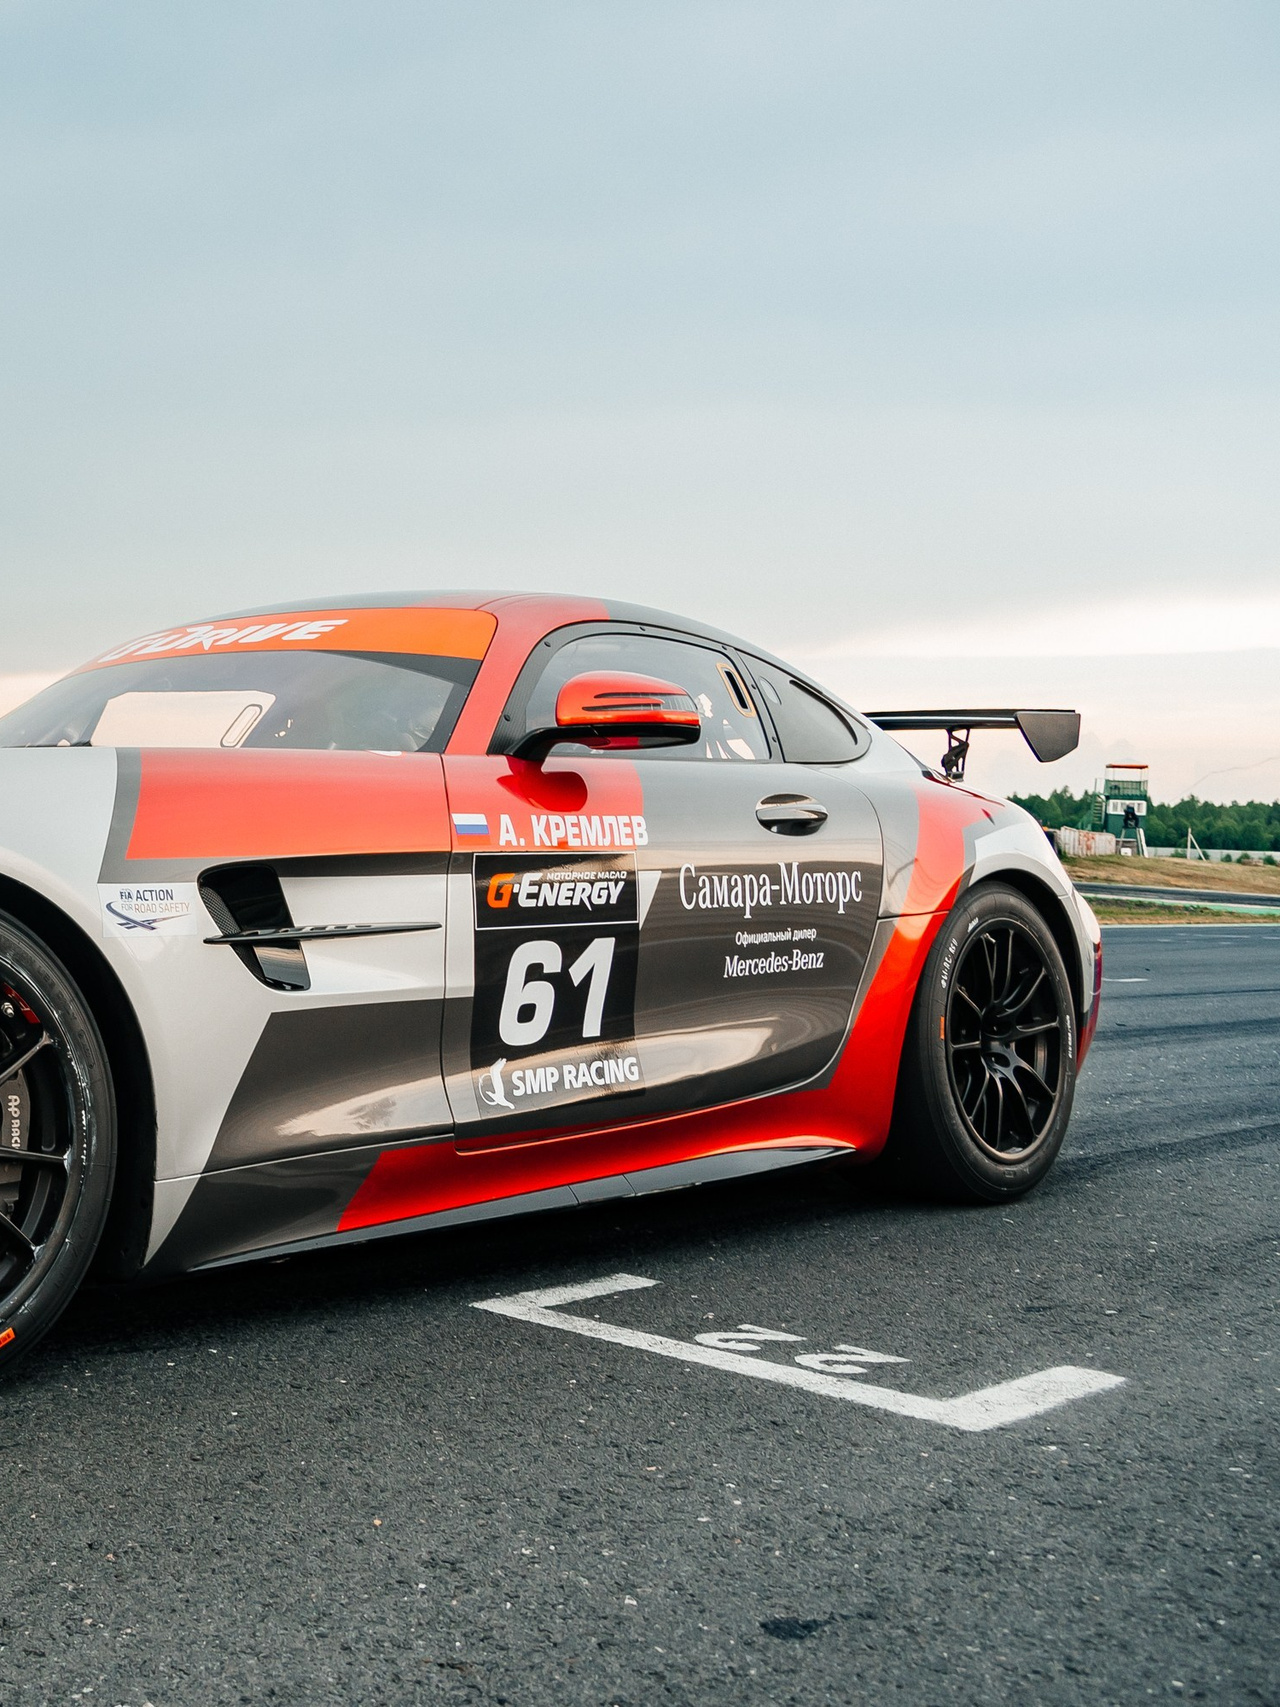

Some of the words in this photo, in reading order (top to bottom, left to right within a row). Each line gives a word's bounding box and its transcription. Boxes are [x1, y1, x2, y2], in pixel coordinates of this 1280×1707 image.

[530, 814, 649, 847] КРЕМЛЕВ
[546, 871, 596, 880] МОТОРНОЕ
[597, 871, 627, 879] МАСЛО
[679, 861, 863, 919] Самара-Моторс
[119, 891, 133, 900] FIA
[135, 889, 174, 902] ACTION
[121, 903, 134, 912] FOR
[134, 902, 157, 914] ROAD
[158, 902, 190, 913] SAFETY
[735, 928, 792, 948] Официальный
[792, 928, 817, 946] дилер
[723, 949, 825, 978] Mercedes-Benz
[498, 937, 616, 1047] 61
[511, 1066, 560, 1097] SMP
[563, 1057, 639, 1089] RACING
